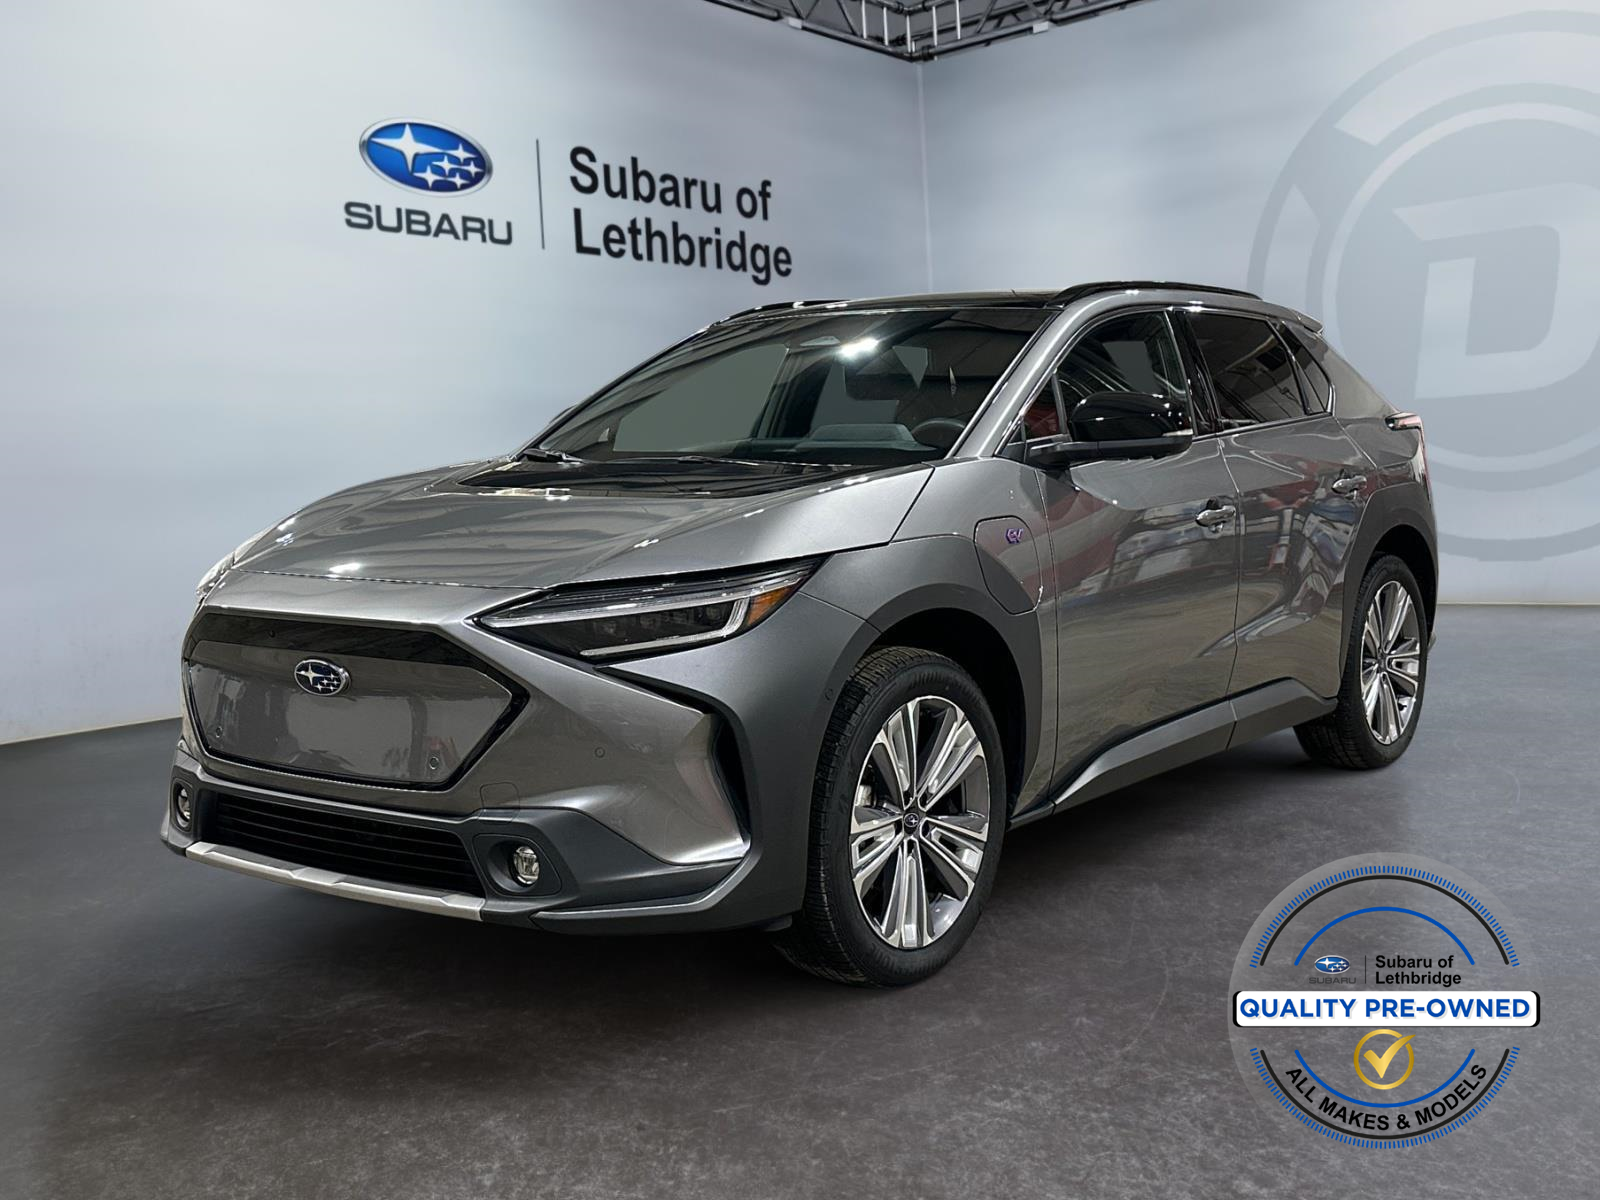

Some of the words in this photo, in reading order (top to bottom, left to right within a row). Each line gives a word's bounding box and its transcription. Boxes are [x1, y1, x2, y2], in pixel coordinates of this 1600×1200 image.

[569, 146, 722, 214] Subaru
[736, 180, 772, 221] of
[344, 201, 513, 245] SUBARU
[573, 208, 793, 286] Lethbridge
